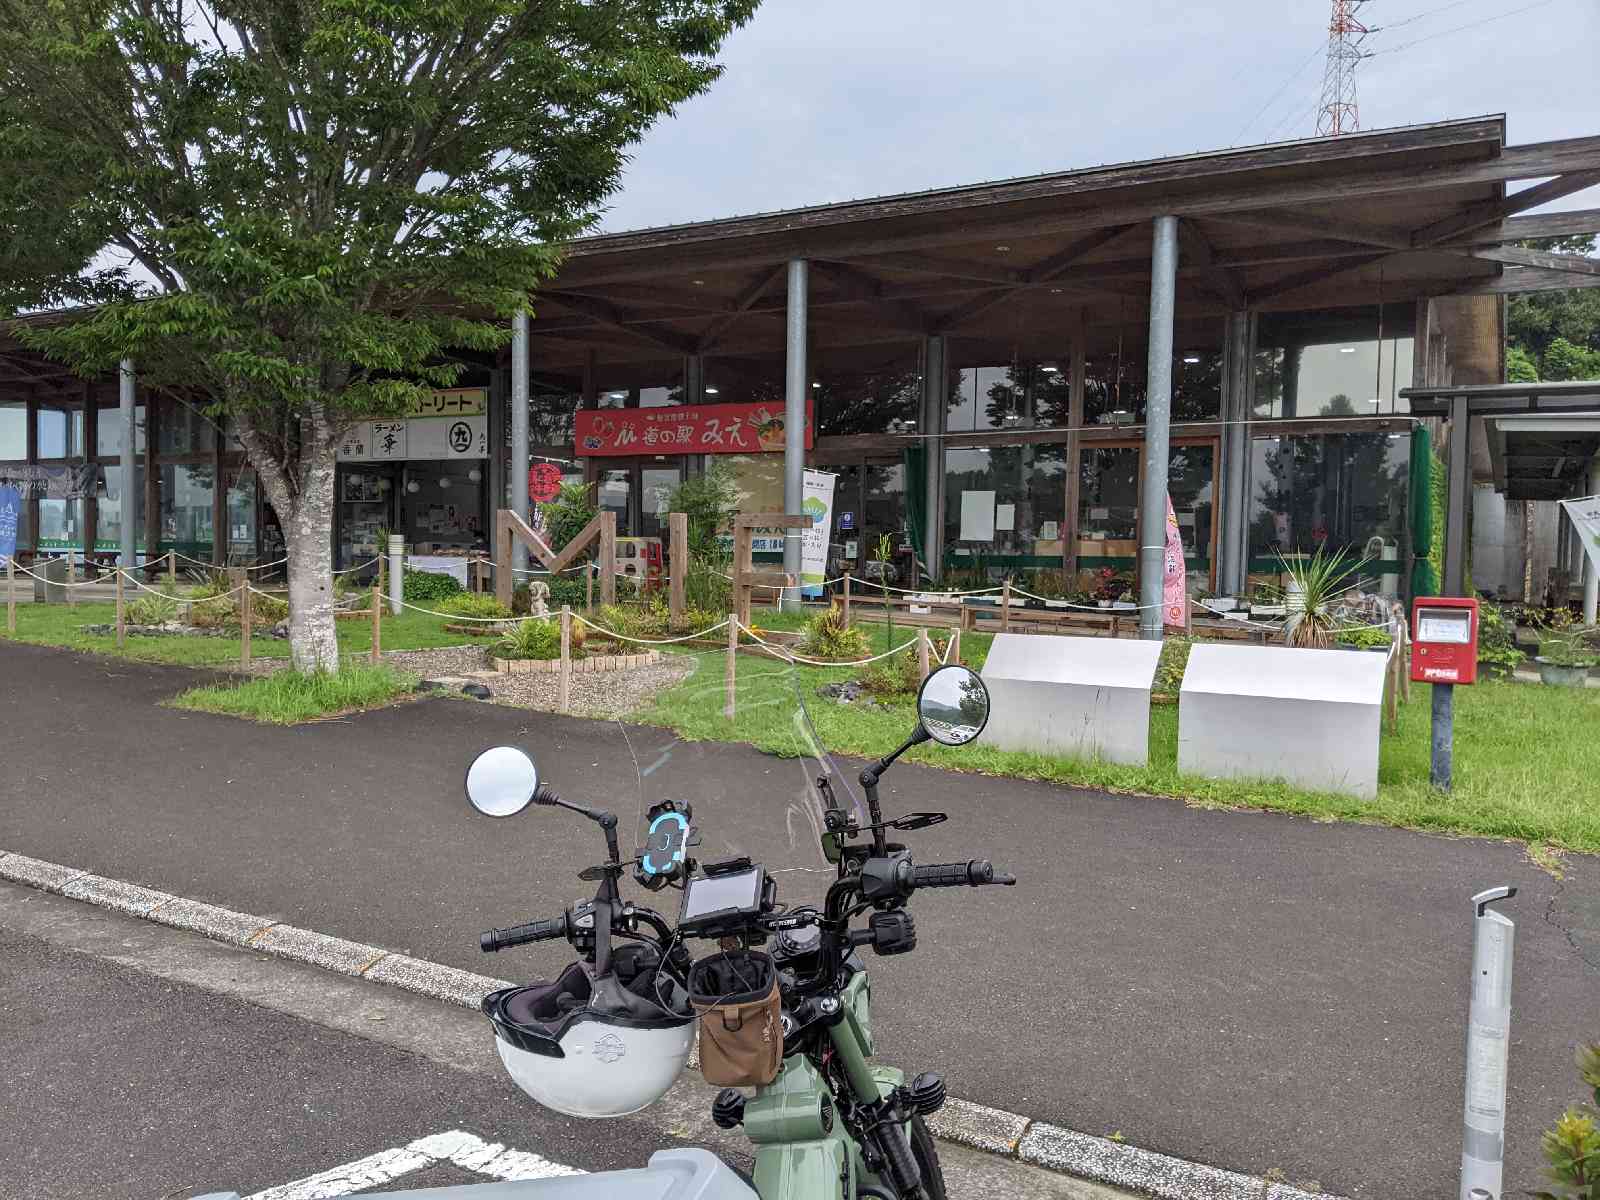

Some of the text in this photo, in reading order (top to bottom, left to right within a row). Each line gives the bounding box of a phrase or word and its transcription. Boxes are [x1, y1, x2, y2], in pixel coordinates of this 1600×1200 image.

[375, 423, 405, 433] ラーメン
[642, 424, 695, 447] 道の駅
[701, 416, 748, 447] みえ
